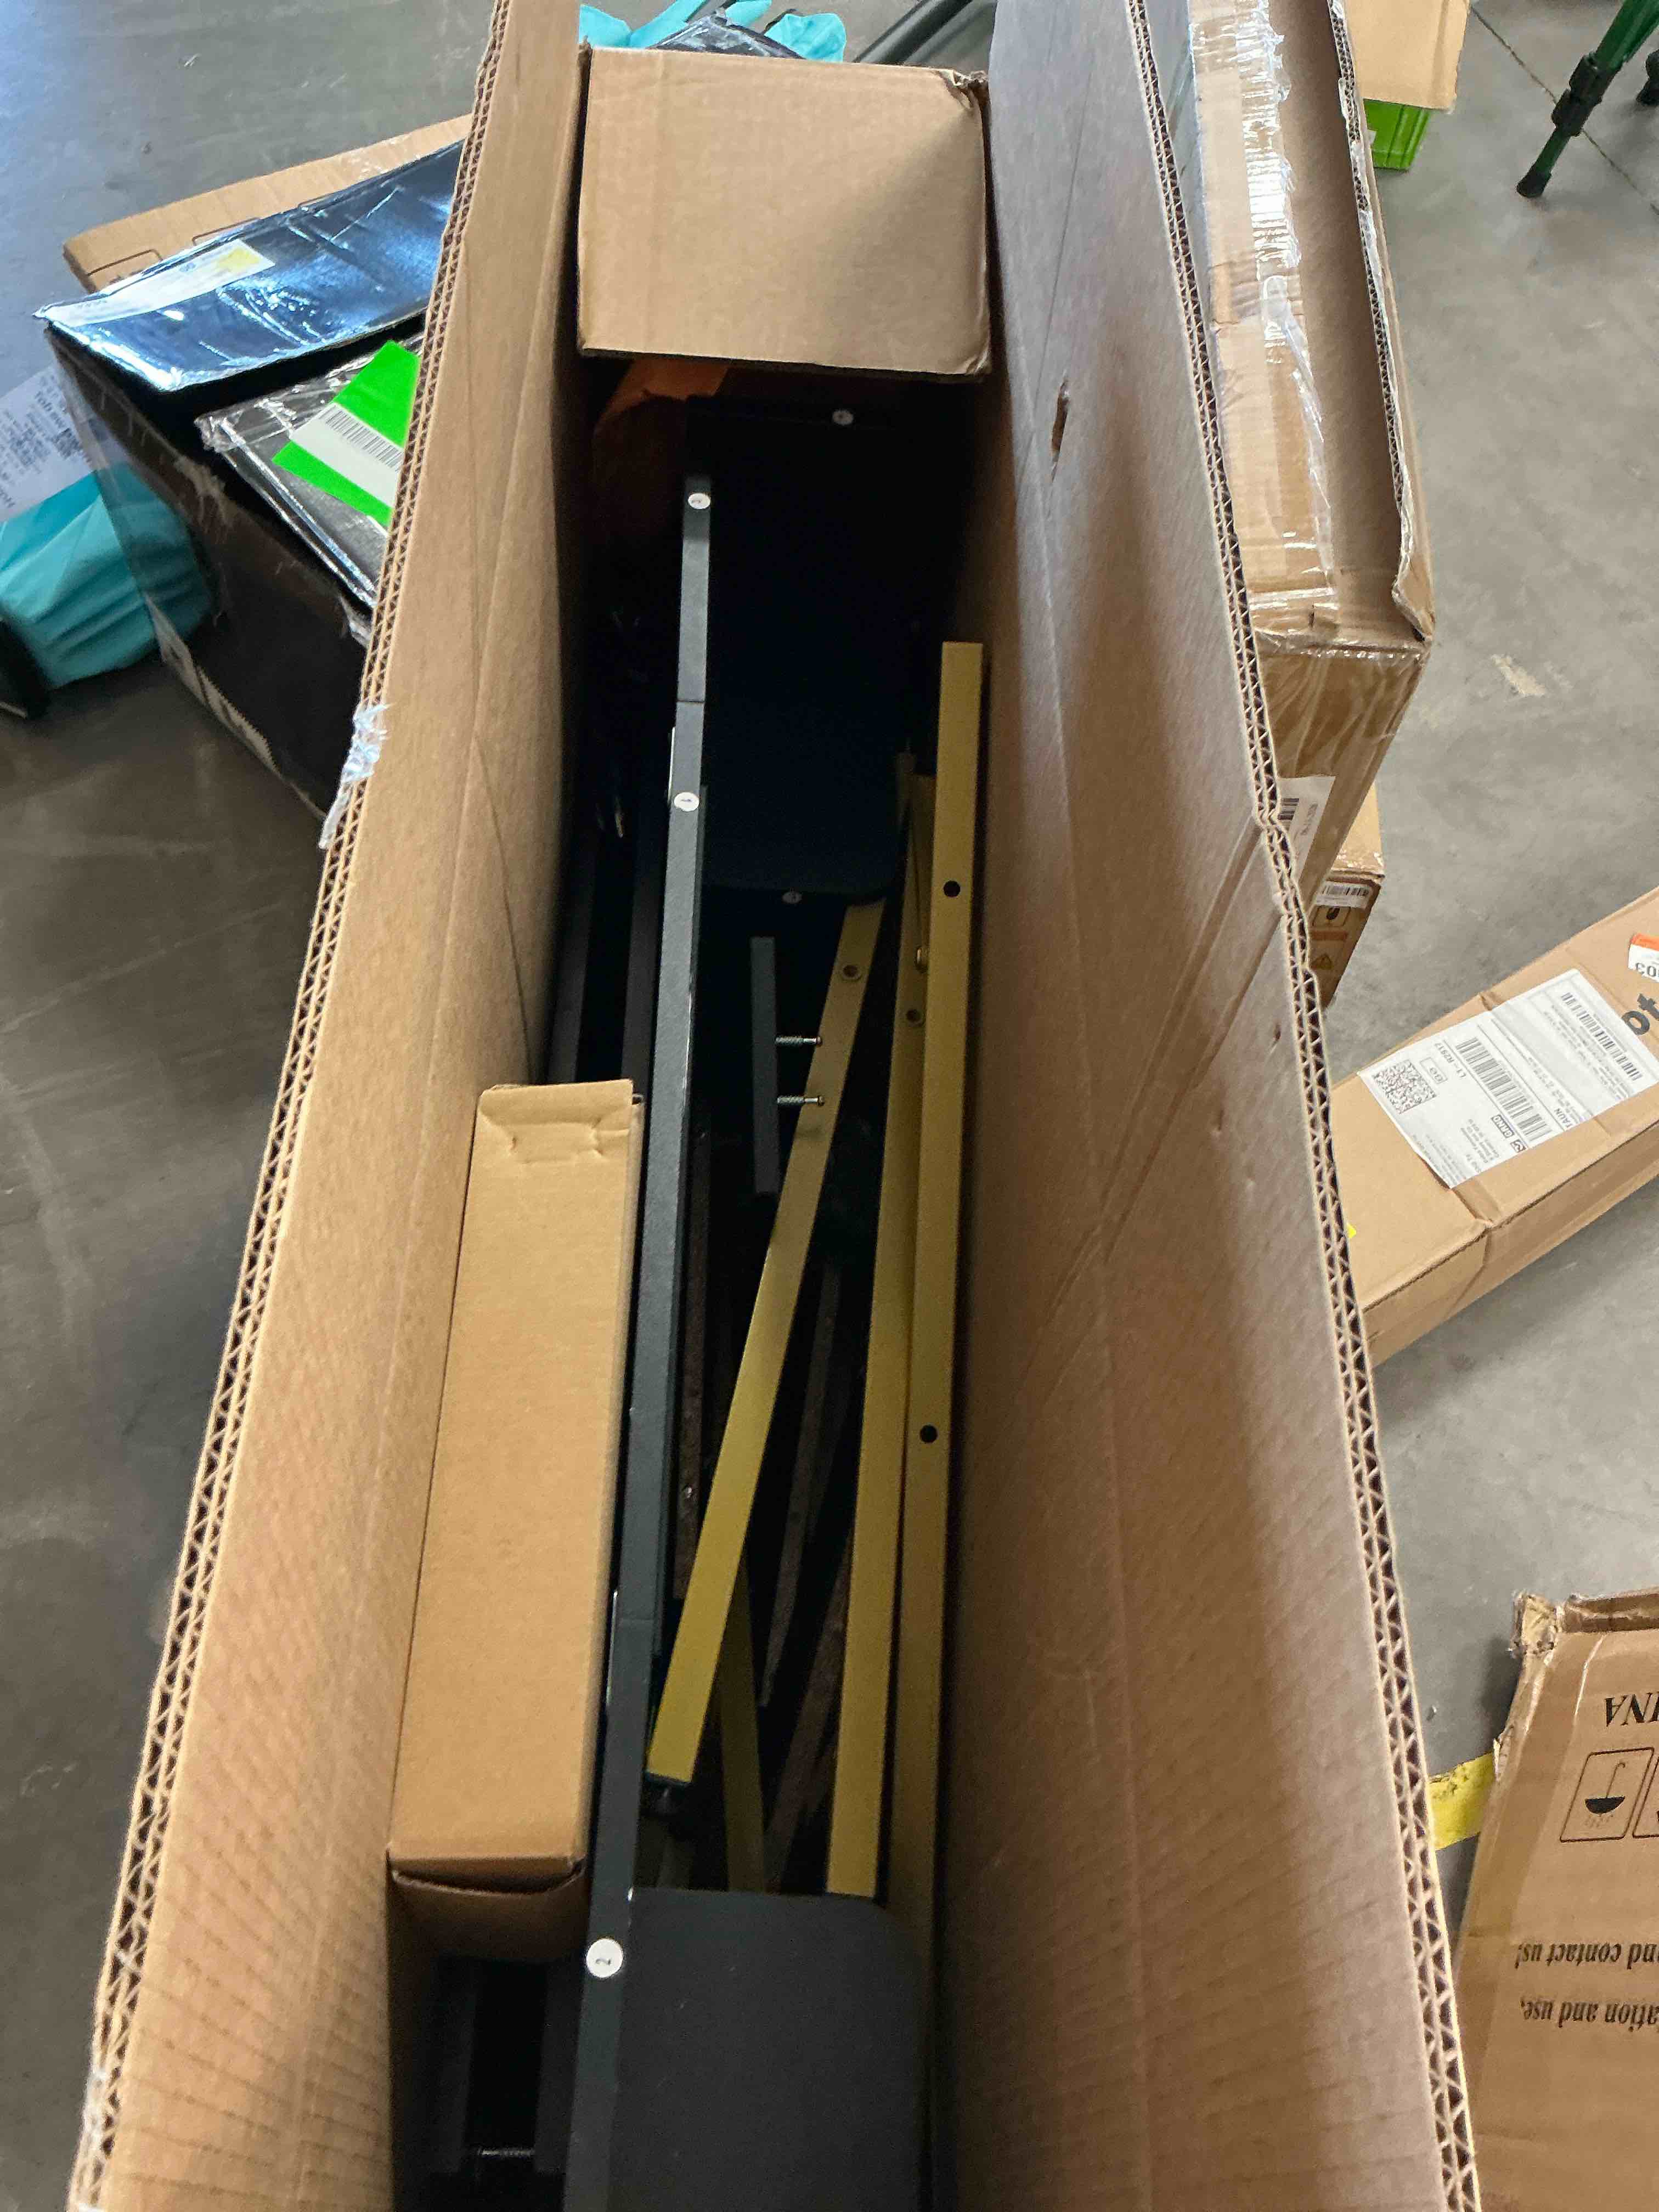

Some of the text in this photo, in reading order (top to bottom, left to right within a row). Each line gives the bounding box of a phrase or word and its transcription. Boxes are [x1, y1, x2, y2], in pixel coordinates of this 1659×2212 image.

[1515, 1942, 1659, 1970] nd contact us!
[1559, 2002, 1599, 2028] and
[1605, 2002, 1659, 2032] ation
